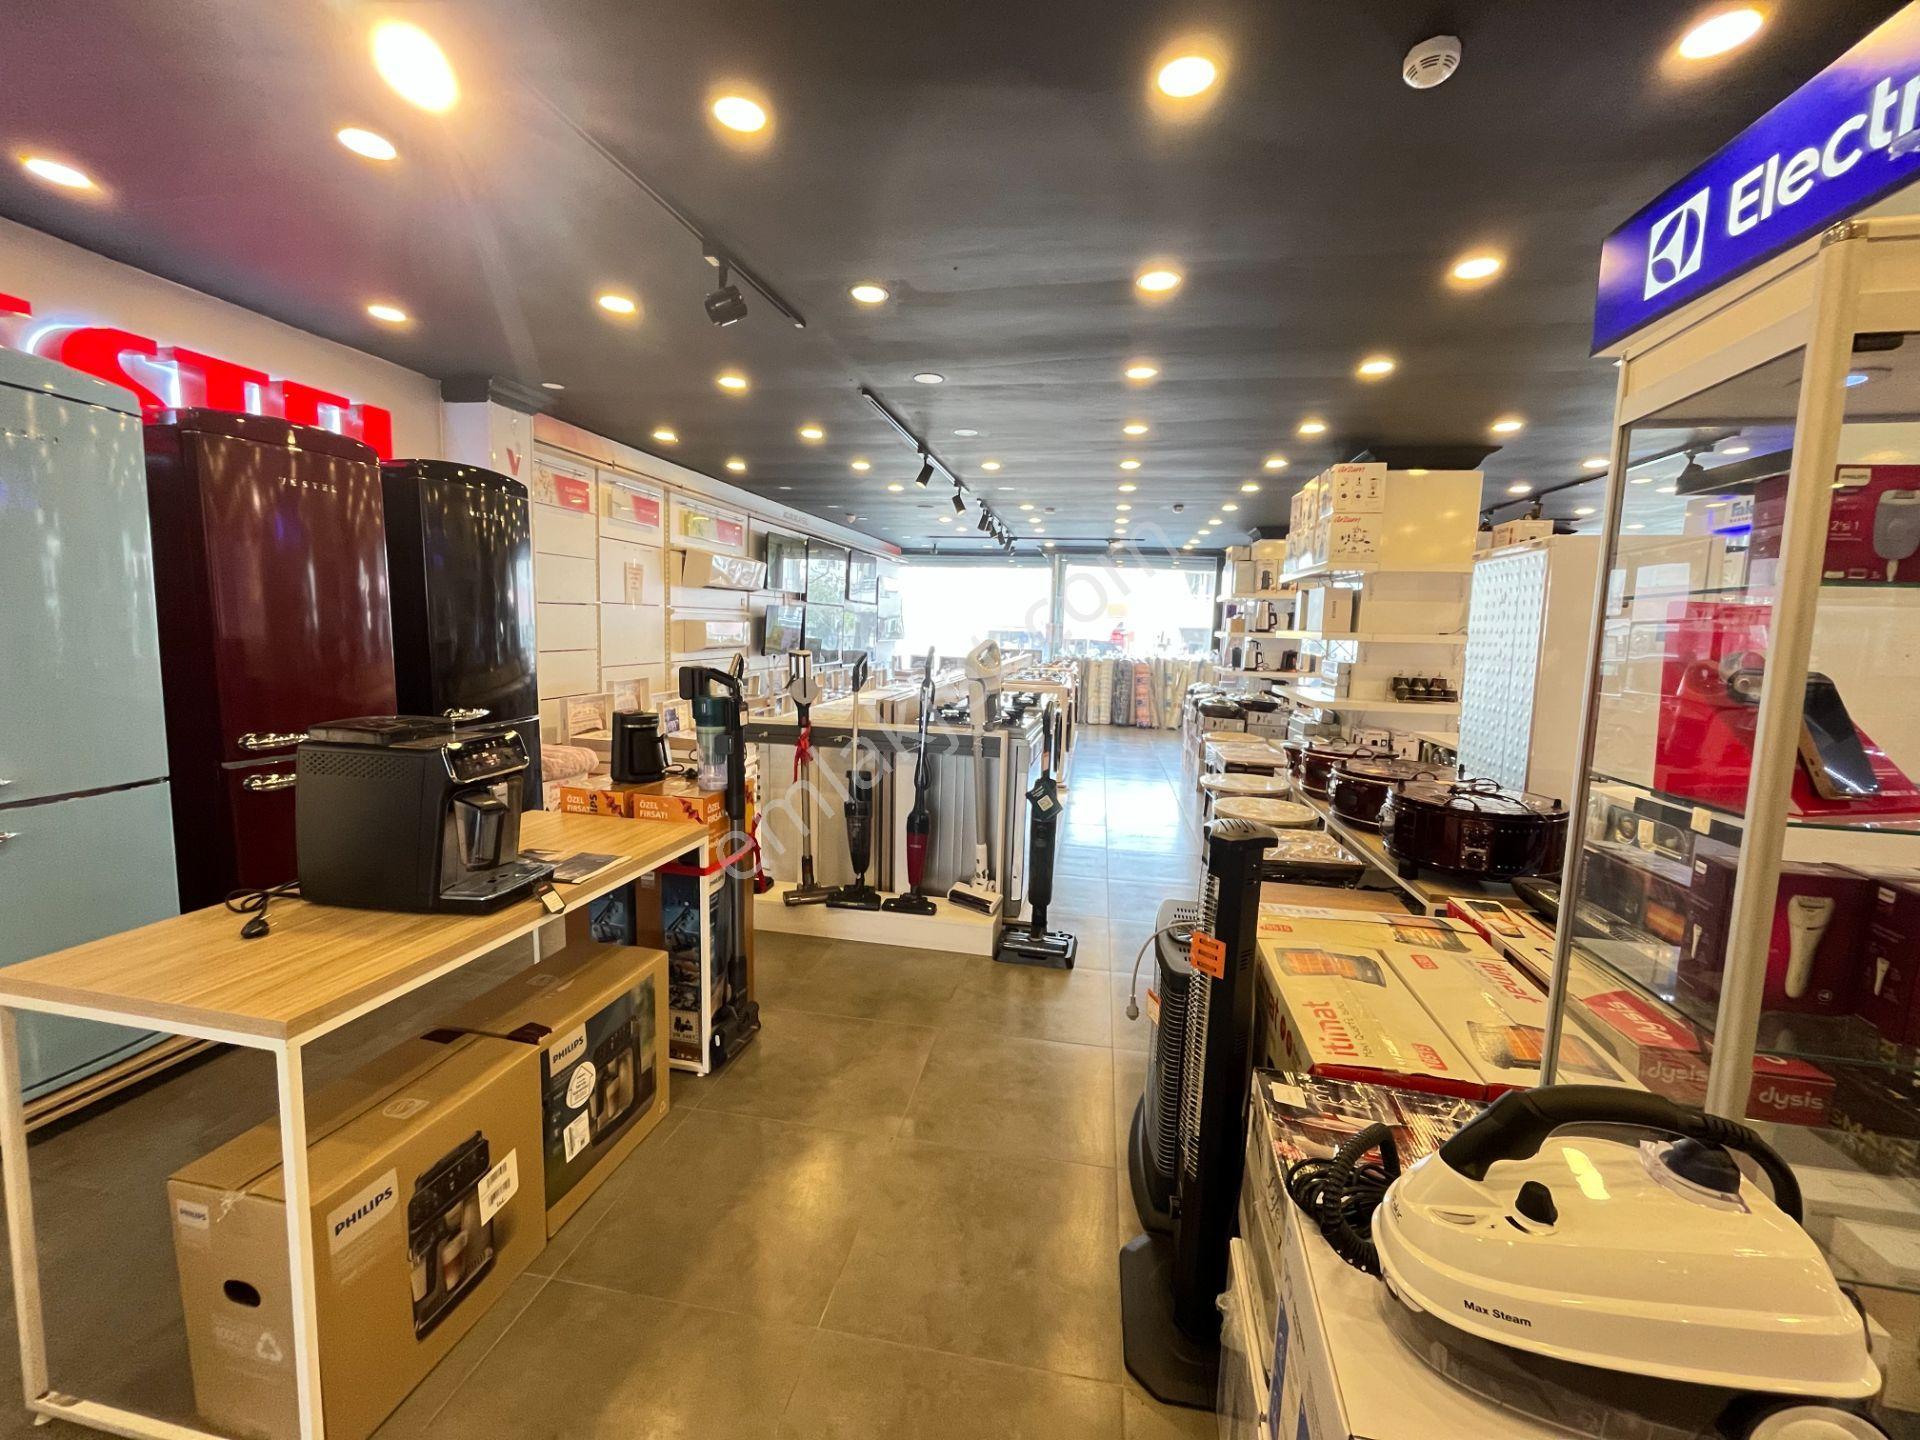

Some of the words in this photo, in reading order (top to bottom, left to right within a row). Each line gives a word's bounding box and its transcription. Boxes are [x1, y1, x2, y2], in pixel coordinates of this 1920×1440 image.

[278, 477, 337, 494] VESTEL
[566, 794, 585, 805] ÖZEL
[639, 799, 659, 810] ÖZEL
[707, 801, 721, 814] ÖZEL
[639, 809, 668, 820] FIRSAT!
[1302, 1001, 1360, 1057] itimat
[1607, 1000, 1674, 1041] dysis
[552, 1035, 584, 1064] PHILIPS
[1758, 1086, 1825, 1110] dysis
[335, 1186, 393, 1236] PHILIPS
[1464, 1299, 1490, 1315] Max
[1492, 1307, 1532, 1327] Steam
